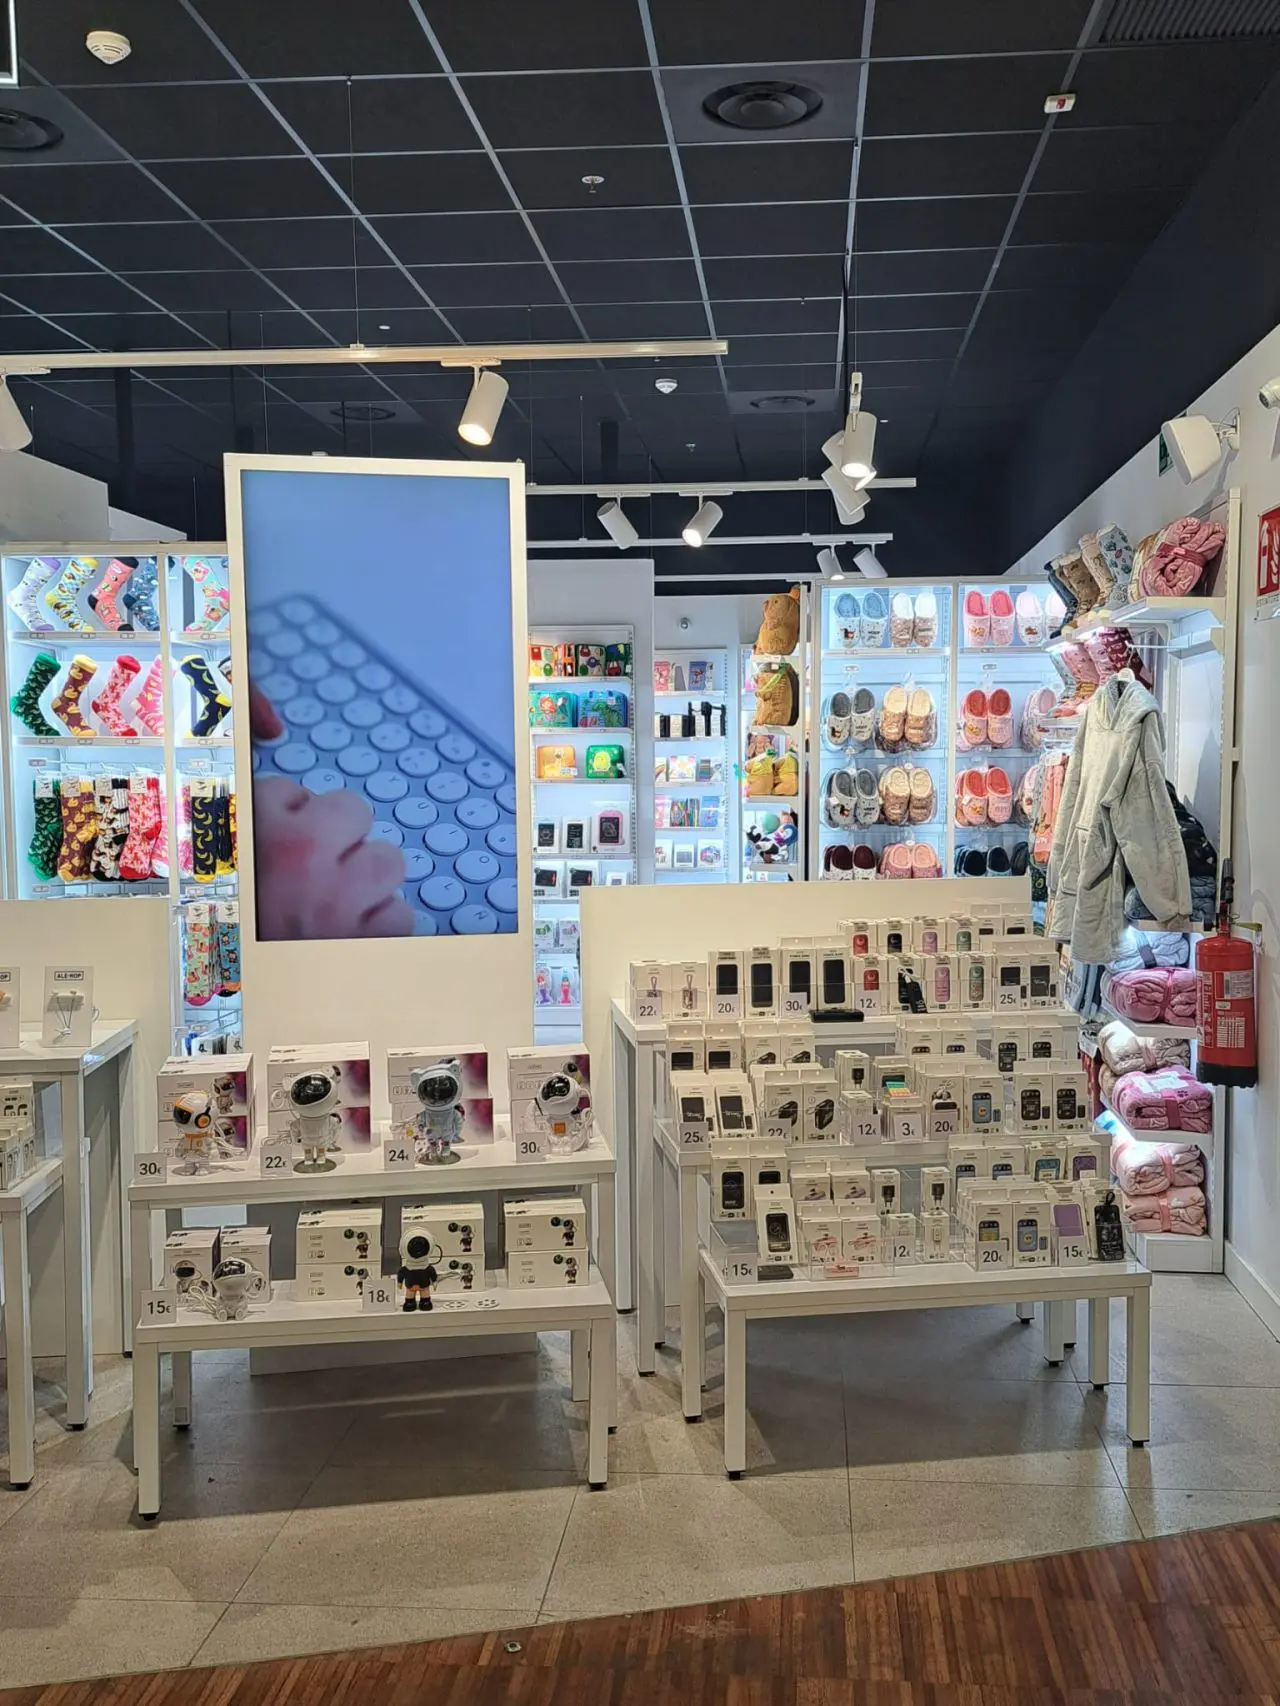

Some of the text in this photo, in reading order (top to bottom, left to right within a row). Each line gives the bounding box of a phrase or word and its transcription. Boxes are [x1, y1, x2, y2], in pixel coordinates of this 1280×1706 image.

[417, 801, 430, 810] U
[411, 854, 425, 864] K
[785, 1000, 803, 1011] 30€
[859, 998, 877, 1009] 12€
[1000, 993, 1017, 1005] 25€
[639, 1005, 657, 1017] 22€
[717, 1002, 736, 1014] 20€
[858, 1123, 876, 1136] 12€
[902, 1122, 915, 1136] 3€
[934, 1120, 953, 1133] 20€
[684, 1131, 704, 1144] 25€
[520, 1141, 541, 1154] 30€
[264, 1155, 287, 1169] 22€
[388, 1149, 409, 1162] 24€
[139, 1162, 162, 1175] 30€
[982, 1250, 1003, 1263] 20€
[1063, 1245, 1084, 1259] 15€
[732, 1263, 753, 1276] 15€
[367, 1289, 390, 1303] 18€
[147, 1301, 171, 1315] 15€
